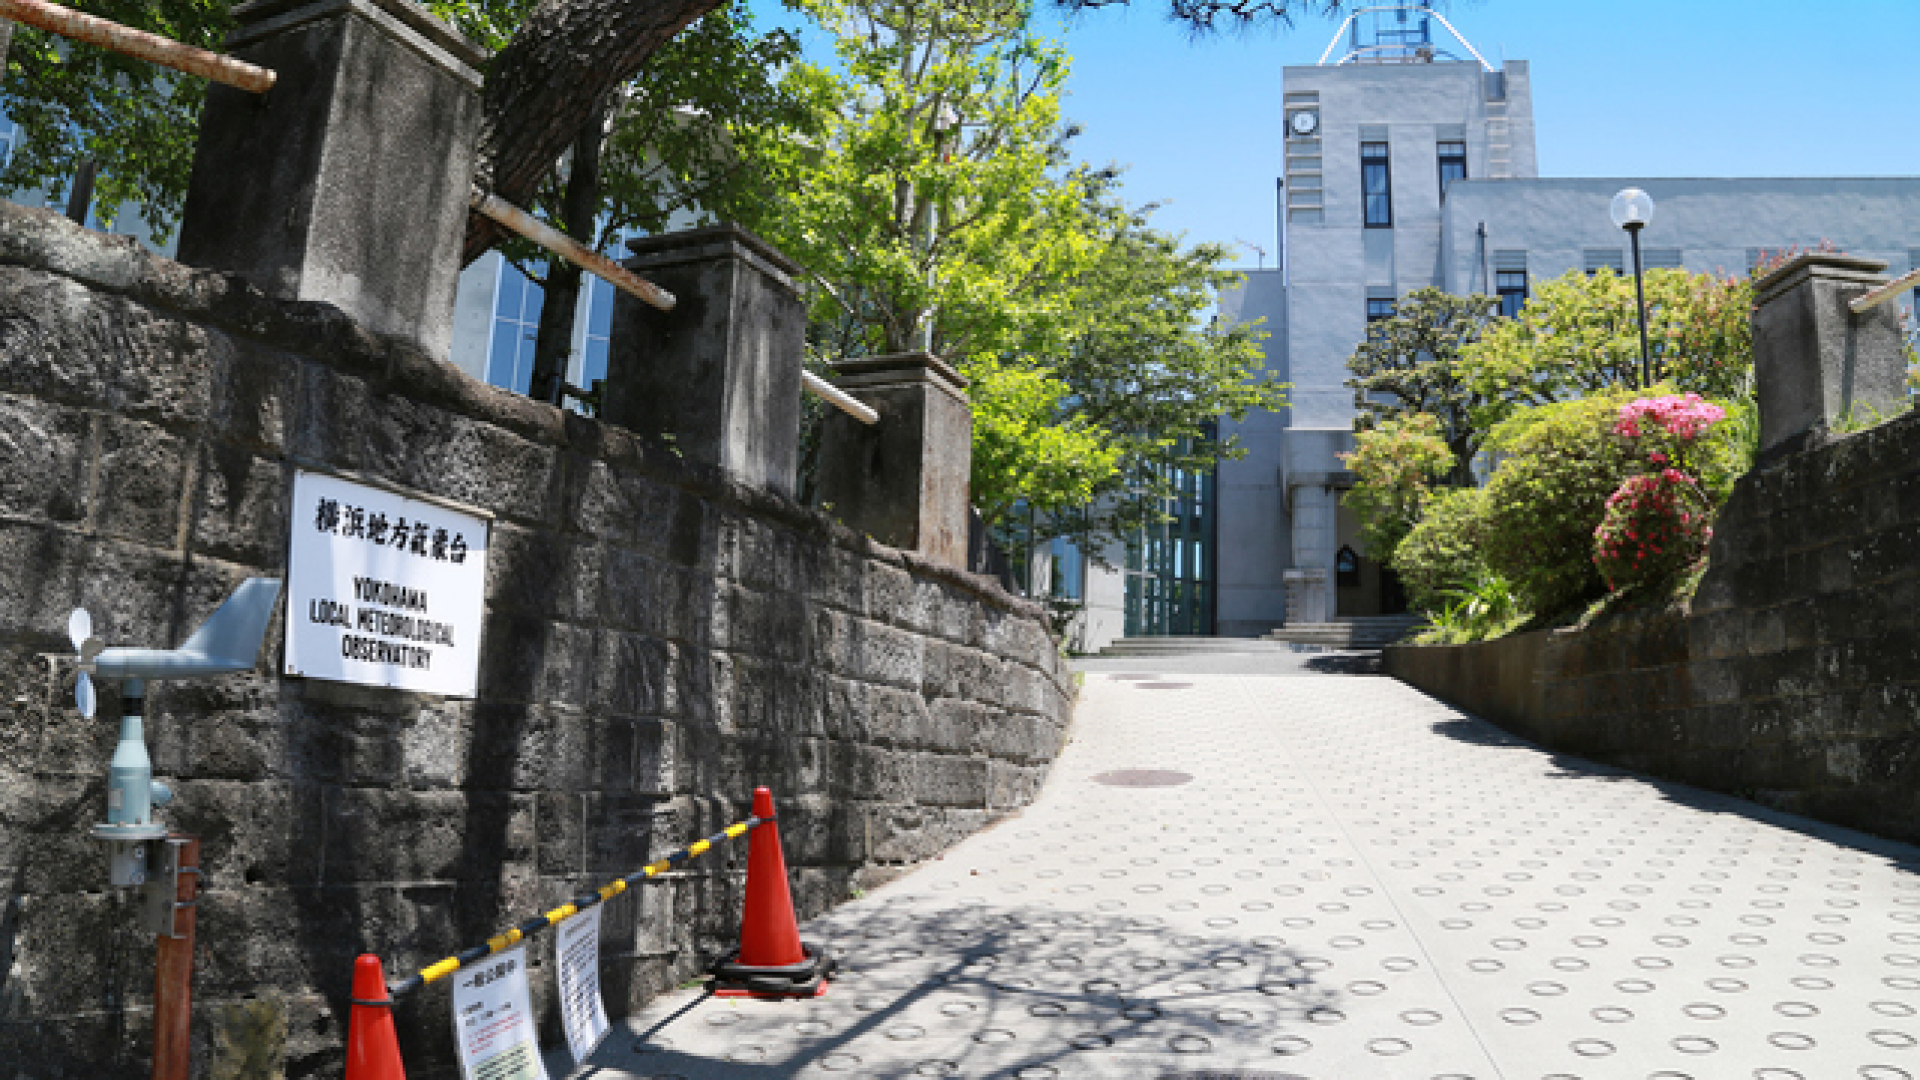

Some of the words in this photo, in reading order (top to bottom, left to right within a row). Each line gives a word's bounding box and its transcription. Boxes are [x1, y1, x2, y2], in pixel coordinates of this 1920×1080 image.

[354, 576, 427, 614] YOKOHAMA
[309, 599, 352, 629] LOCAL
[357, 608, 455, 647] METEOROLOGICAL
[342, 635, 433, 671] OBSERVATORY
